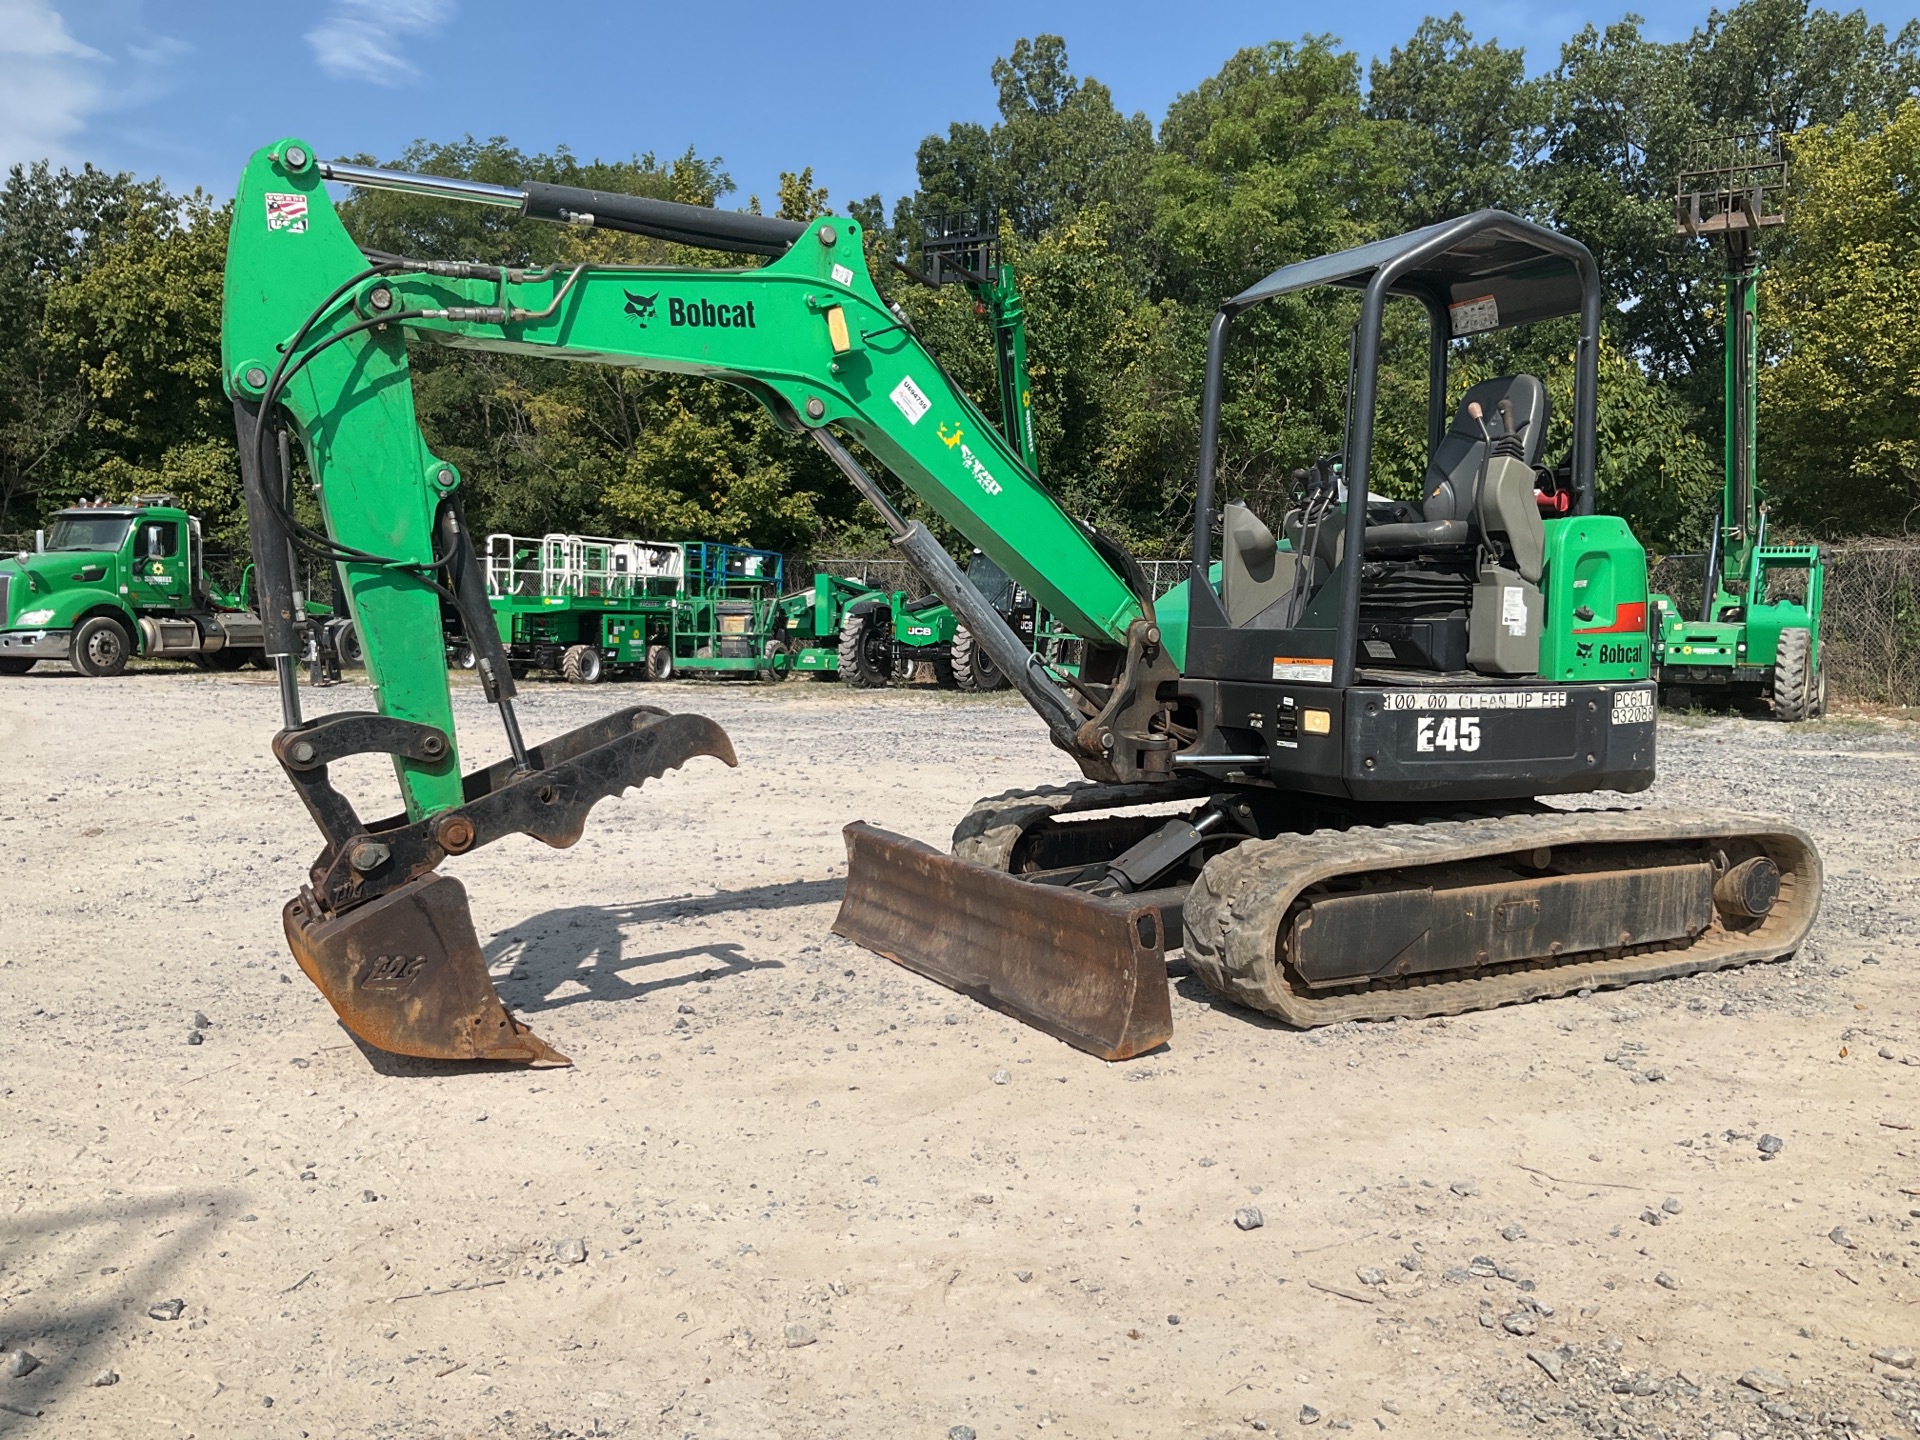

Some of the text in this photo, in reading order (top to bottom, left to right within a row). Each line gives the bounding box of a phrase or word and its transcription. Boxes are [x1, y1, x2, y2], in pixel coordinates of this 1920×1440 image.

[668, 297, 756, 328] Bobcat
[907, 627, 931, 635] JCB
[1021, 621, 1033, 630] JCB
[1599, 644, 1642, 664] Bobcat
[1459, 694, 1507, 709] CLEAN
[1516, 693, 1532, 708] UP
[1541, 692, 1565, 708] FEE
[1616, 691, 1651, 708] PC617
[1612, 707, 1653, 723] 932088
[1417, 717, 1481, 752] E45
